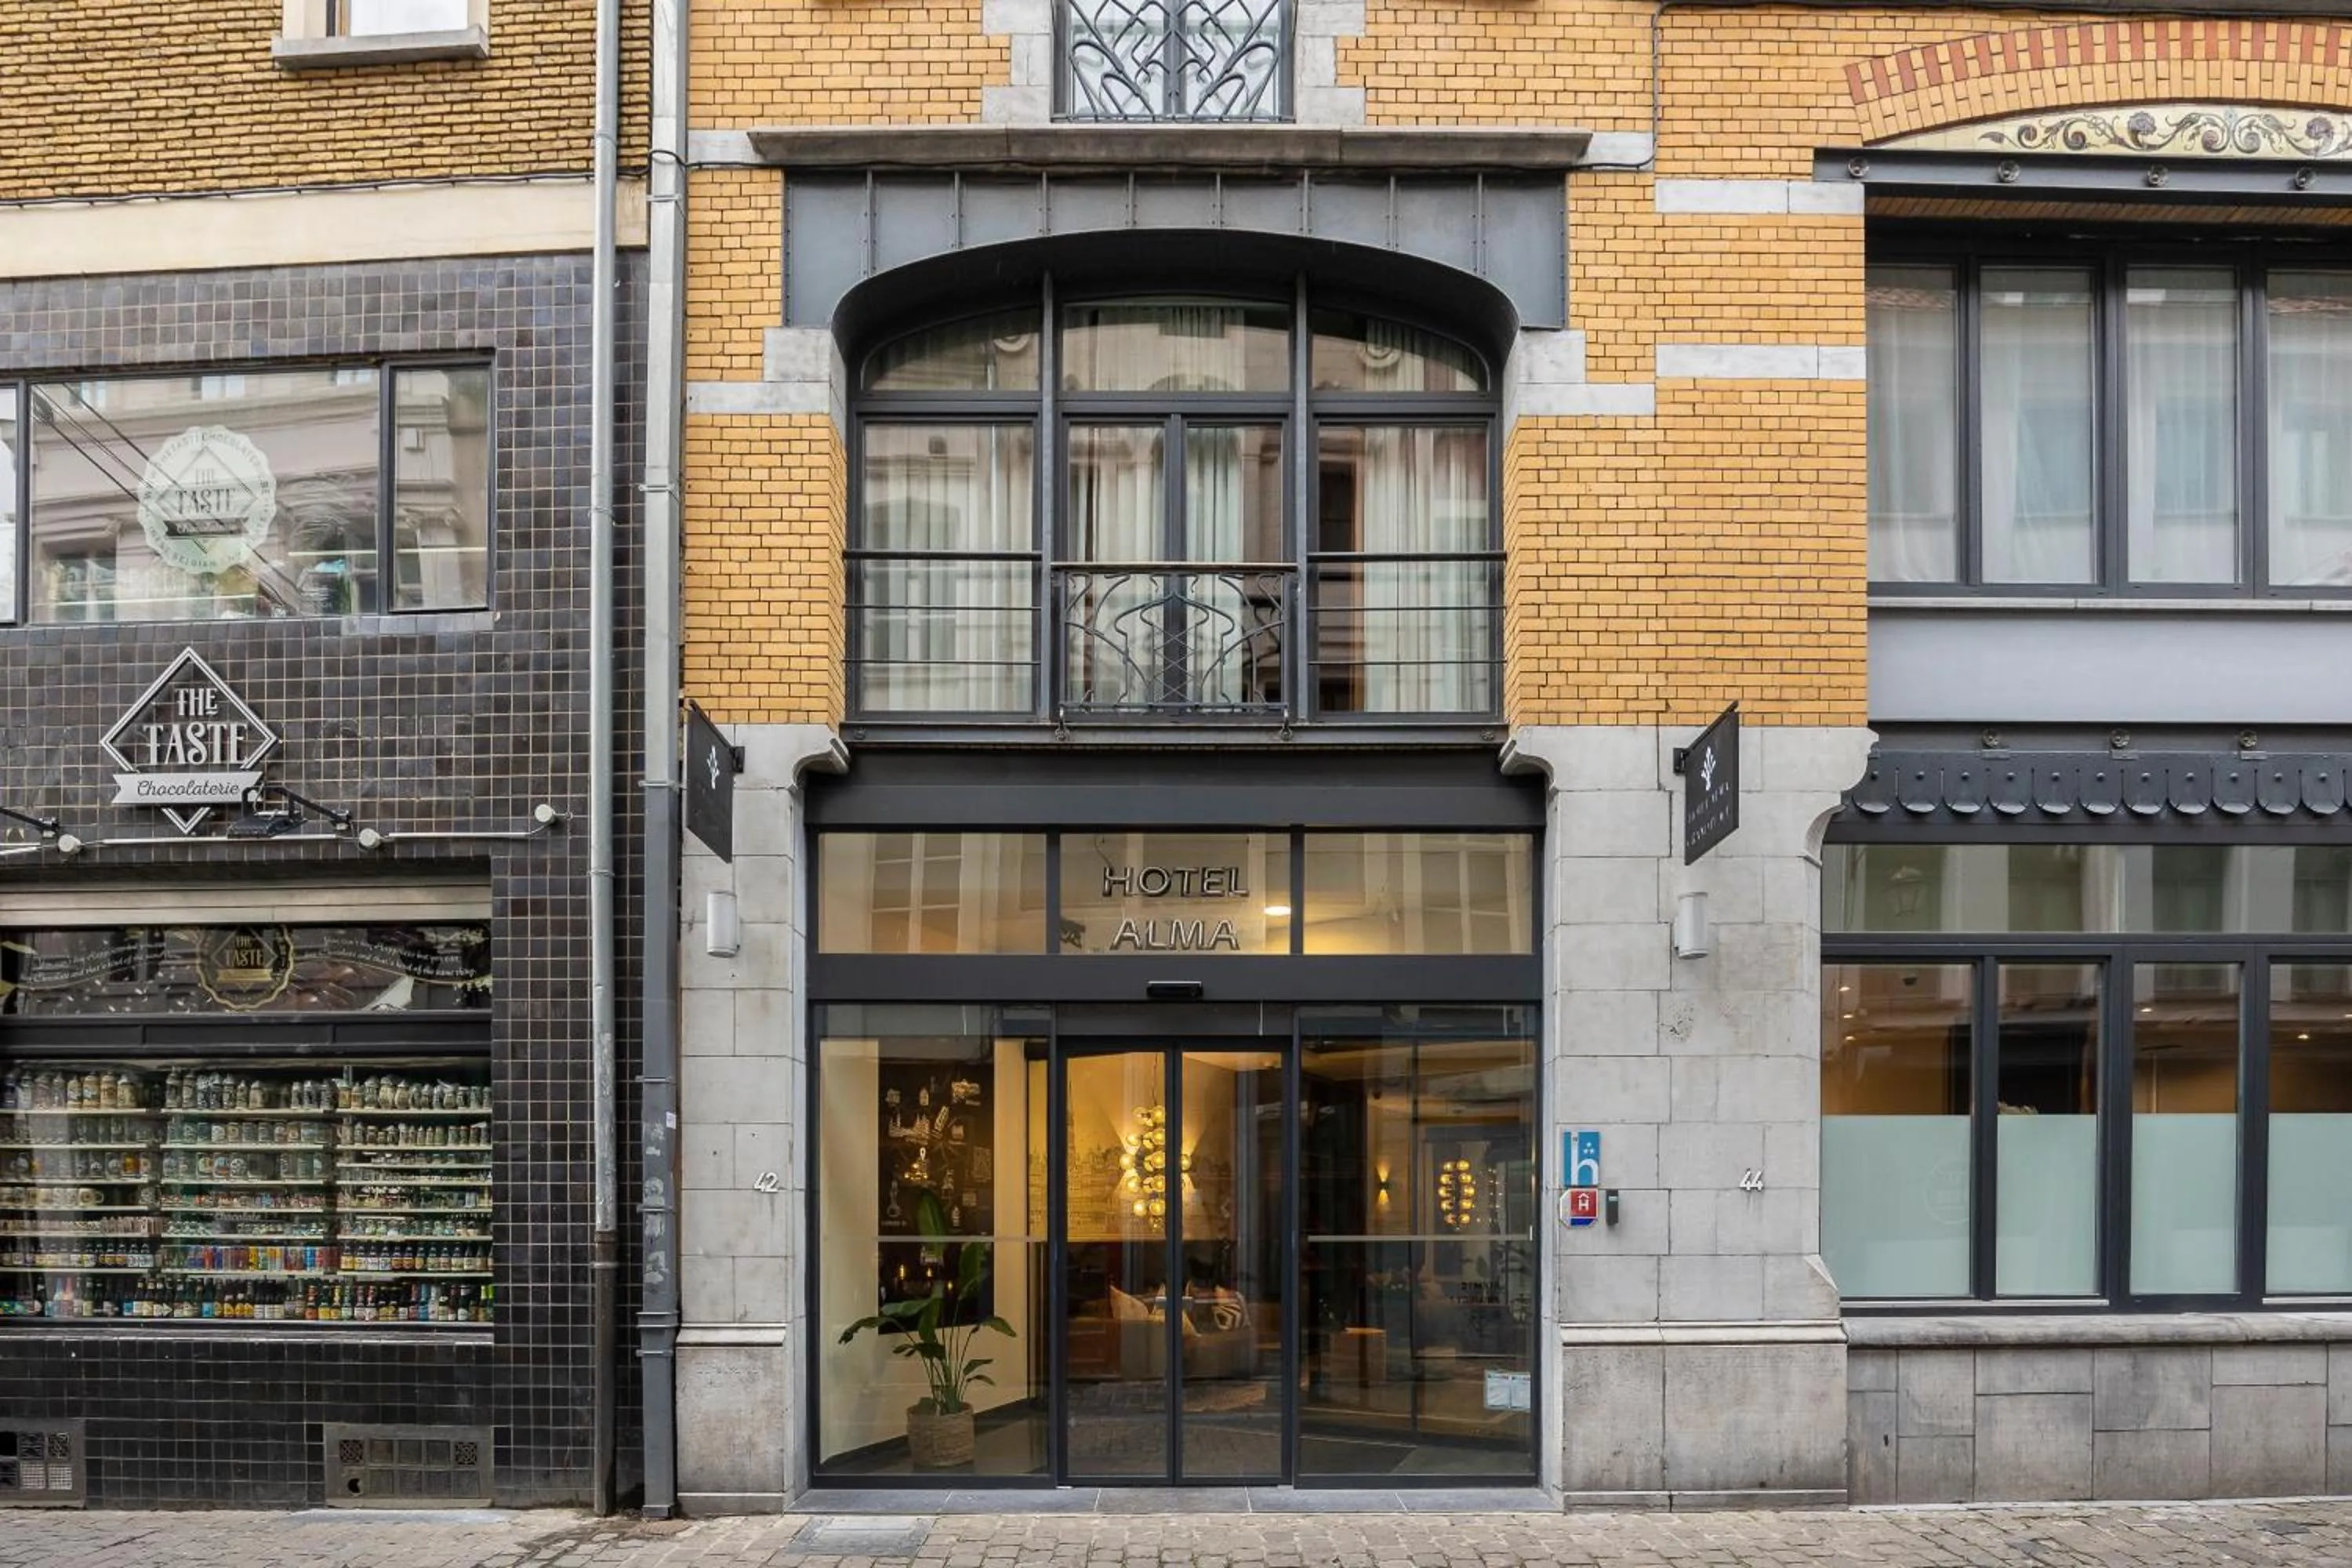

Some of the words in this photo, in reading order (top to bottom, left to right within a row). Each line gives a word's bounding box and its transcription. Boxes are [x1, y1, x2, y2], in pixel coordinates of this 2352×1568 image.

[176, 488, 236, 514] TASTE
[175, 688, 218, 716] THE
[143, 721, 248, 765] TASTE
[137, 780, 240, 797] Chocolaterie
[1102, 866, 1249, 897] HOTEL
[1110, 917, 1240, 950] ALMA
[225, 949, 264, 966] TASTE
[753, 1171, 779, 1193] 42
[1739, 1168, 1764, 1192] 44
